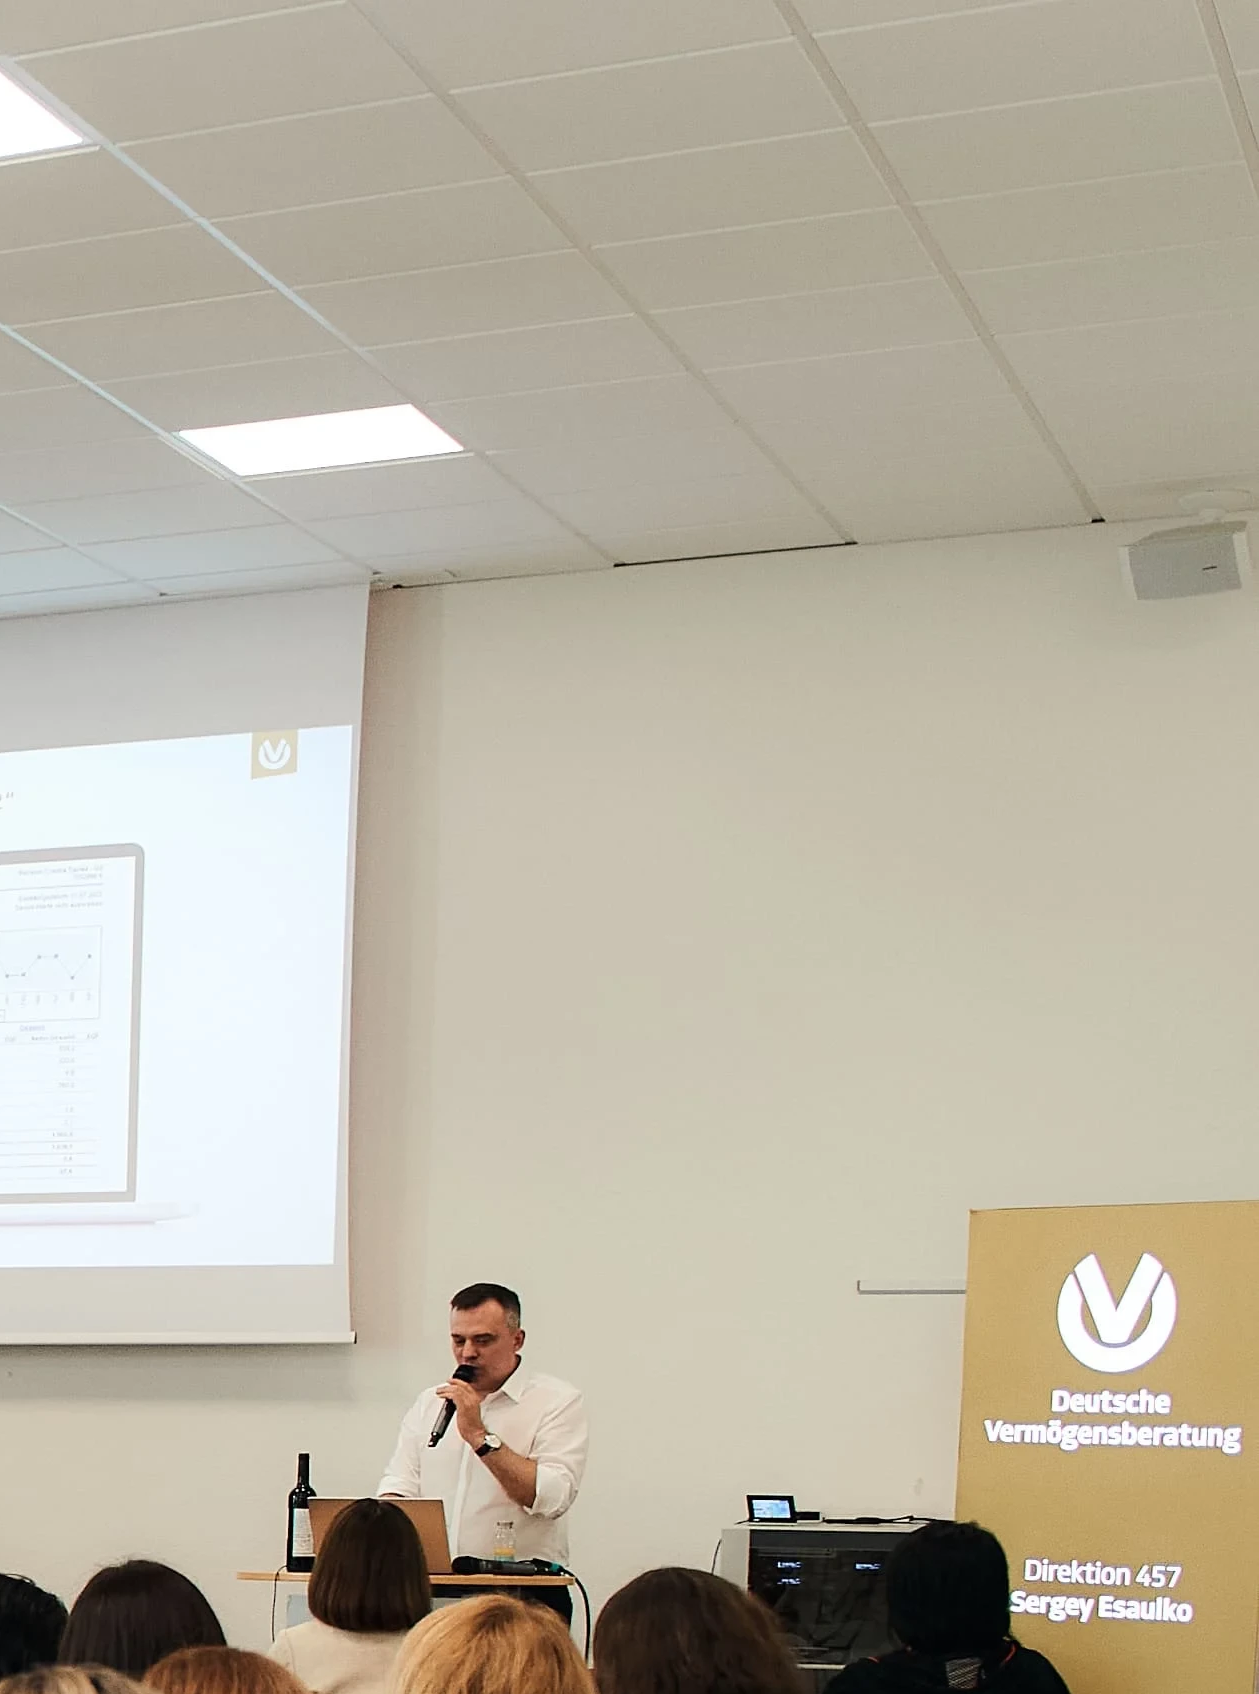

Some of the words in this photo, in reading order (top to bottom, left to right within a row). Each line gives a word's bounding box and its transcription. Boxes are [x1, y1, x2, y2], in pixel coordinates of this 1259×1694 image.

[1051, 1389, 1171, 1414] Deutsche
[984, 1419, 1242, 1455] Vermögensberatung
[1024, 1559, 1131, 1586] Direktion
[1135, 1565, 1183, 1589] 457
[1010, 1590, 1094, 1623] Sergey
[1097, 1596, 1194, 1623] Esaulko
